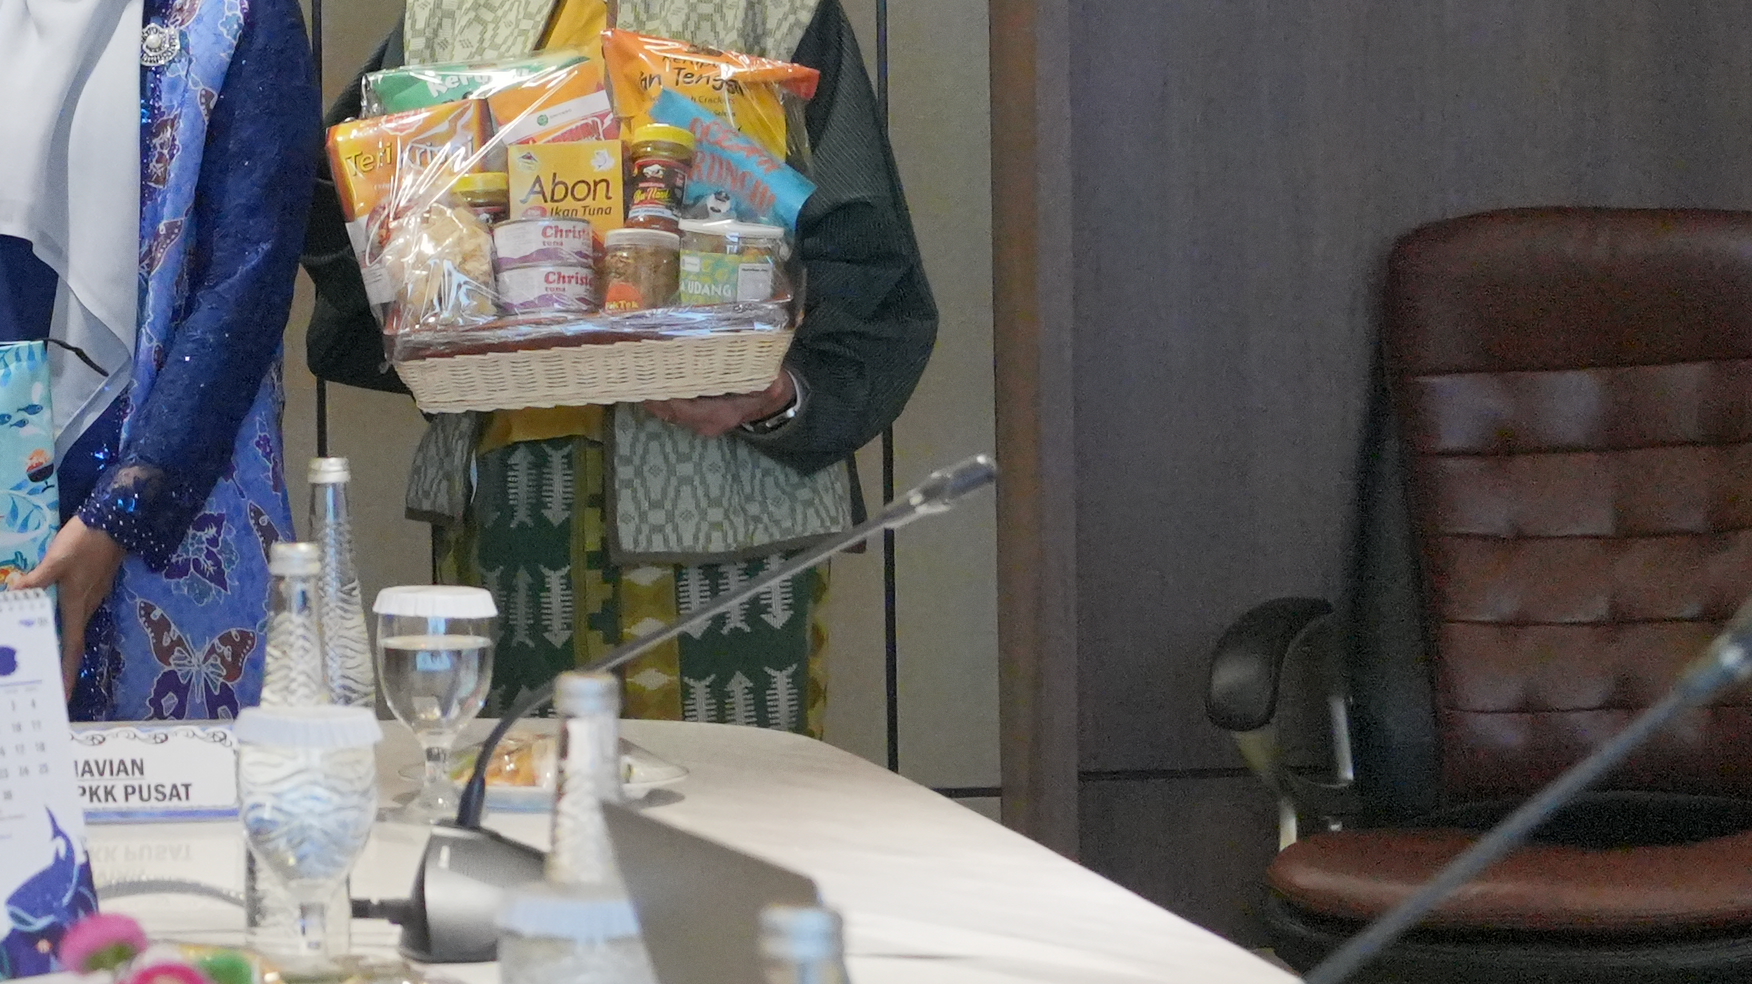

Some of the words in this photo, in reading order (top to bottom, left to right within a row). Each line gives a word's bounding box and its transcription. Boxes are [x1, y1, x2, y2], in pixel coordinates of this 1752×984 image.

[346, 142, 392, 176] Teri
[519, 172, 612, 204] Abon
[550, 206, 578, 217] Ikan
[581, 205, 612, 216] Tuna
[74, 758, 144, 777] AVIAN
[124, 783, 192, 802] PUSAT
